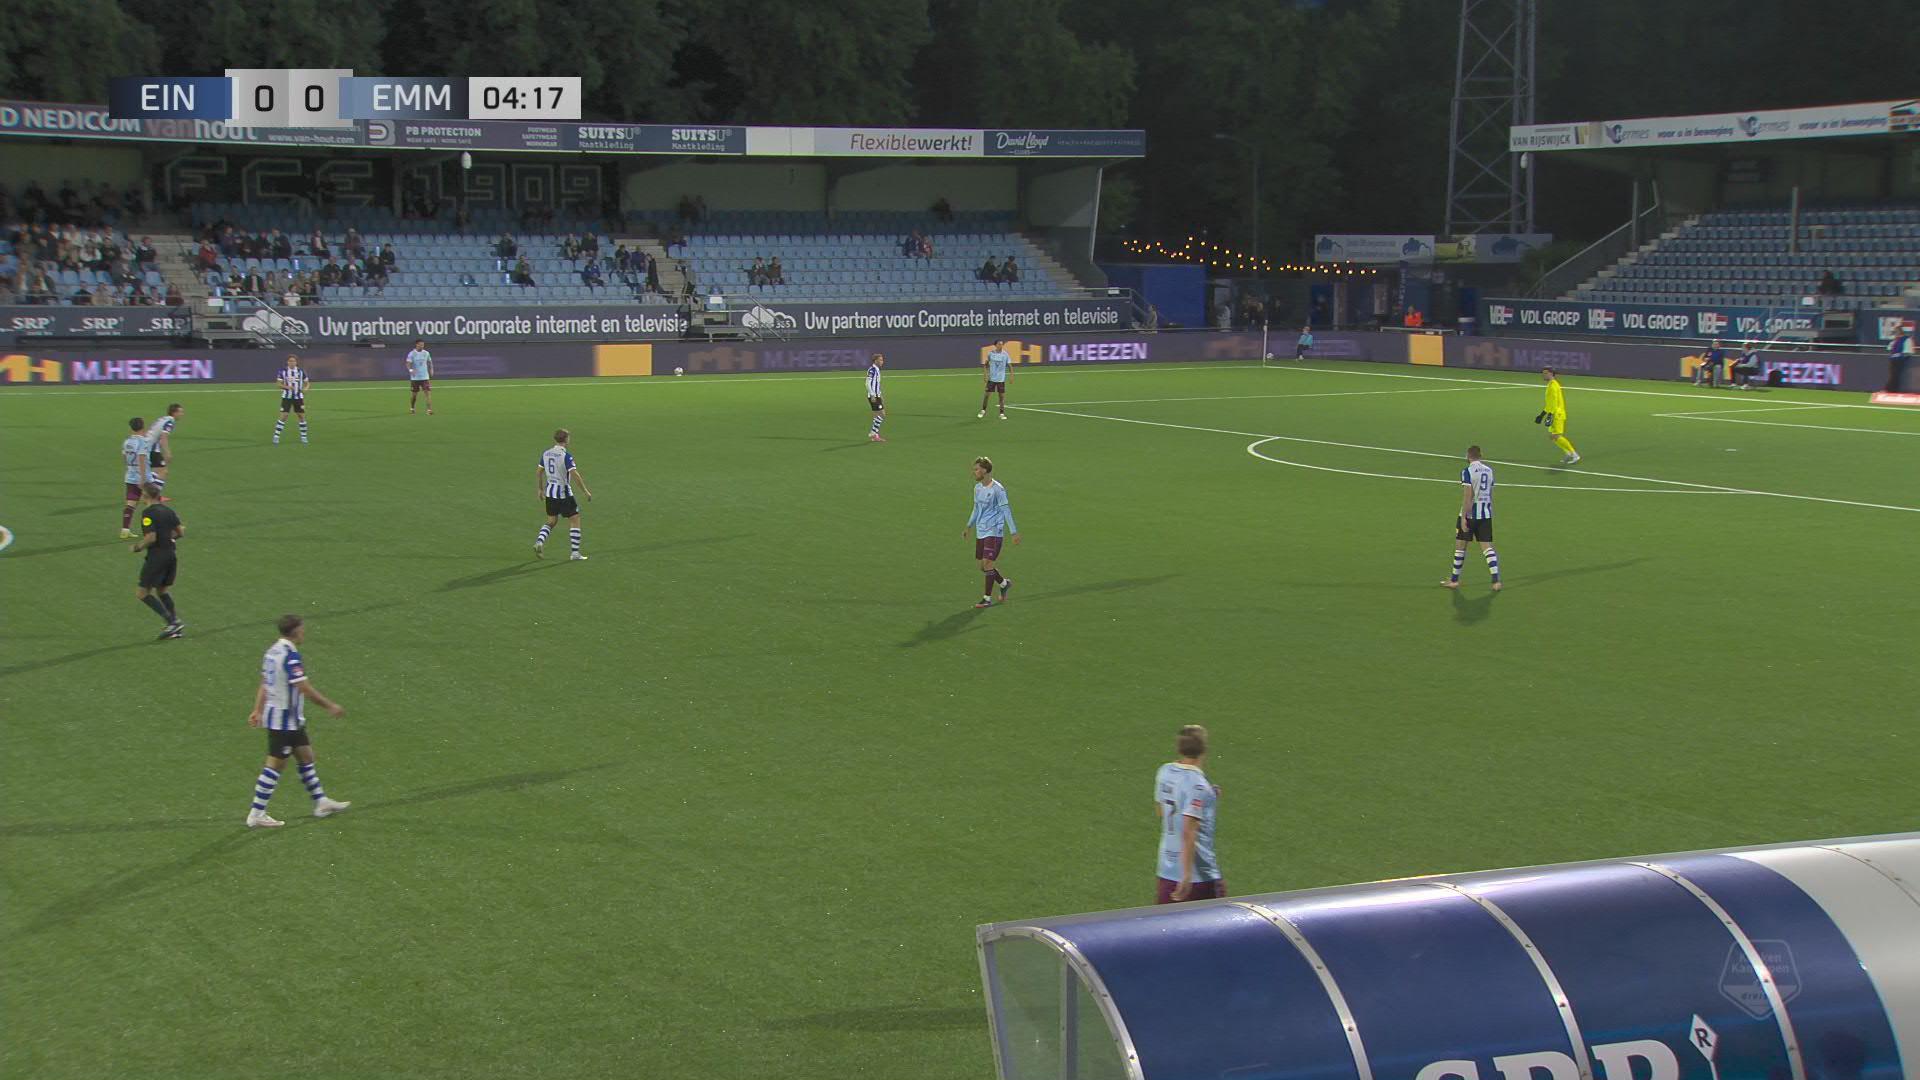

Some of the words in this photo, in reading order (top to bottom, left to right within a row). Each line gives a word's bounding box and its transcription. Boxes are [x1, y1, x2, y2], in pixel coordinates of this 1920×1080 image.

[421, 127, 482, 137] PROTECTION
[995, 132, 1026, 149] David
[1025, 131, 1050, 149] Lloyd
[850, 133, 973, 151] Flexiblewerkt!
[12, 317, 50, 330] SRP
[82, 317, 119, 330] SRP
[804, 311, 829, 330] Uw
[831, 311, 884, 334] partner
[885, 313, 916, 329] voor
[918, 309, 984, 332] Corporate
[987, 308, 1040, 327] internet
[1043, 310, 1061, 325] en
[1064, 306, 1118, 325] televisie
[1519, 309, 1541, 324] VDL
[1543, 310, 1581, 326] GROEP
[1622, 313, 1646, 329] VDL
[1647, 314, 1689, 330] GROEP
[318, 316, 348, 336] Uw
[352, 316, 413, 341] partner
[415, 319, 451, 336] voor
[454, 315, 531, 340] Corporate
[535, 314, 597, 334] internet
[601, 317, 620, 333] en
[624, 313, 689, 333] televisie
[1050, 342, 1148, 362] M.HEEZEN
[72, 359, 214, 381] M.HEEZEN
[548, 457, 555, 474] 6
[1479, 473, 1488, 491] 9
